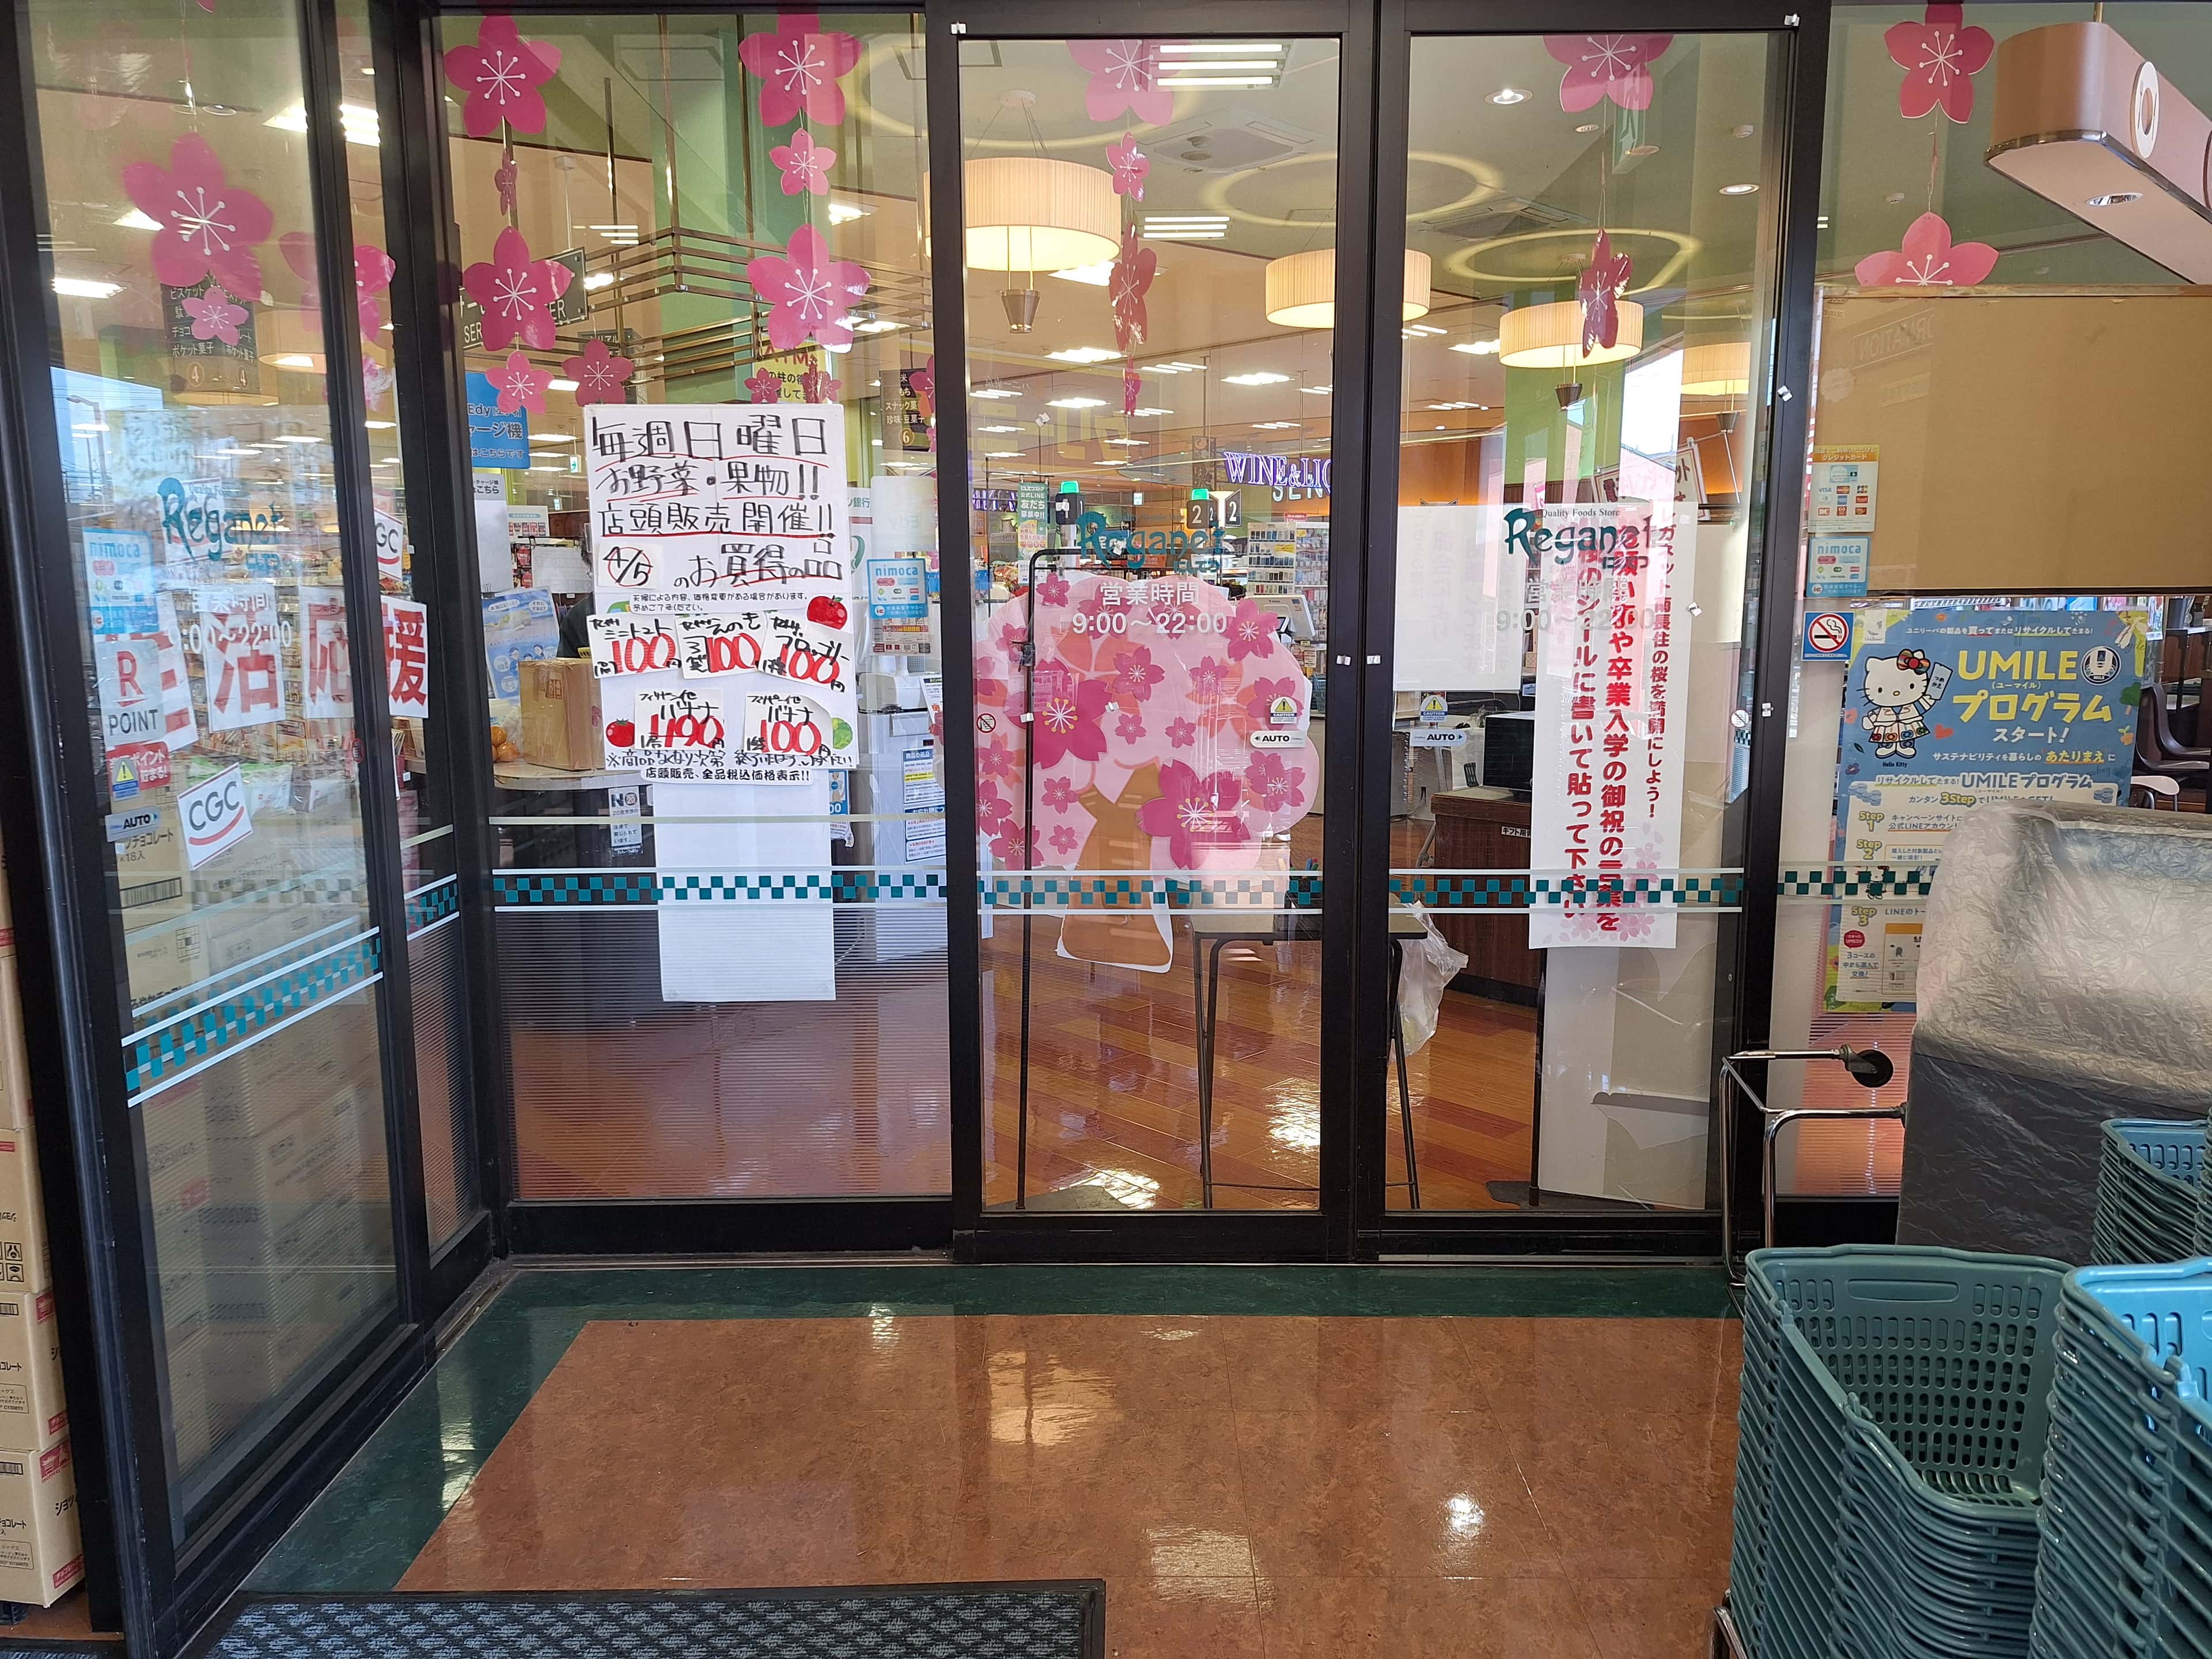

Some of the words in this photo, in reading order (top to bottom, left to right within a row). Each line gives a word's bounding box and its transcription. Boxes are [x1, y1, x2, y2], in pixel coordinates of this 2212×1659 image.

[172, 341, 214, 357] ポケット菓子
[885, 400, 919, 411] スナック菓
[592, 414, 827, 462] 毎週日曜日
[1021, 499, 1045, 509] 友だち
[1573, 509, 1596, 517] Foods
[376, 522, 399, 554] GC
[1817, 543, 1861, 554] nimoca
[876, 565, 918, 577] nimoca
[1100, 582, 1200, 607] 営業時間
[612, 632, 676, 673] 100
[705, 632, 762, 673] 100
[780, 643, 840, 684] 100
[1958, 650, 2079, 681] UMILE
[1992, 681, 2042, 690] (ユーマイル)
[1953, 690, 2112, 724] プログラム
[108, 709, 158, 736] POINT
[760, 719, 822, 756] 100
[1427, 733, 1456, 741] AUTO
[1992, 726, 2070, 743] スタート!
[1896, 761, 1908, 769] Kitty
[646, 767, 809, 781] 店頭販売、全品税込価格表示!!
[1961, 774, 2018, 789] UMILE
[2020, 775, 2093, 789] プログラム
[189, 781, 240, 831] CGC
[1908, 796, 1938, 804] カンタン
[123, 813, 151, 830] AUTO
[1859, 811, 1884, 823] Step
[1856, 839, 1883, 851] Step
[1851, 906, 1877, 916] Step
